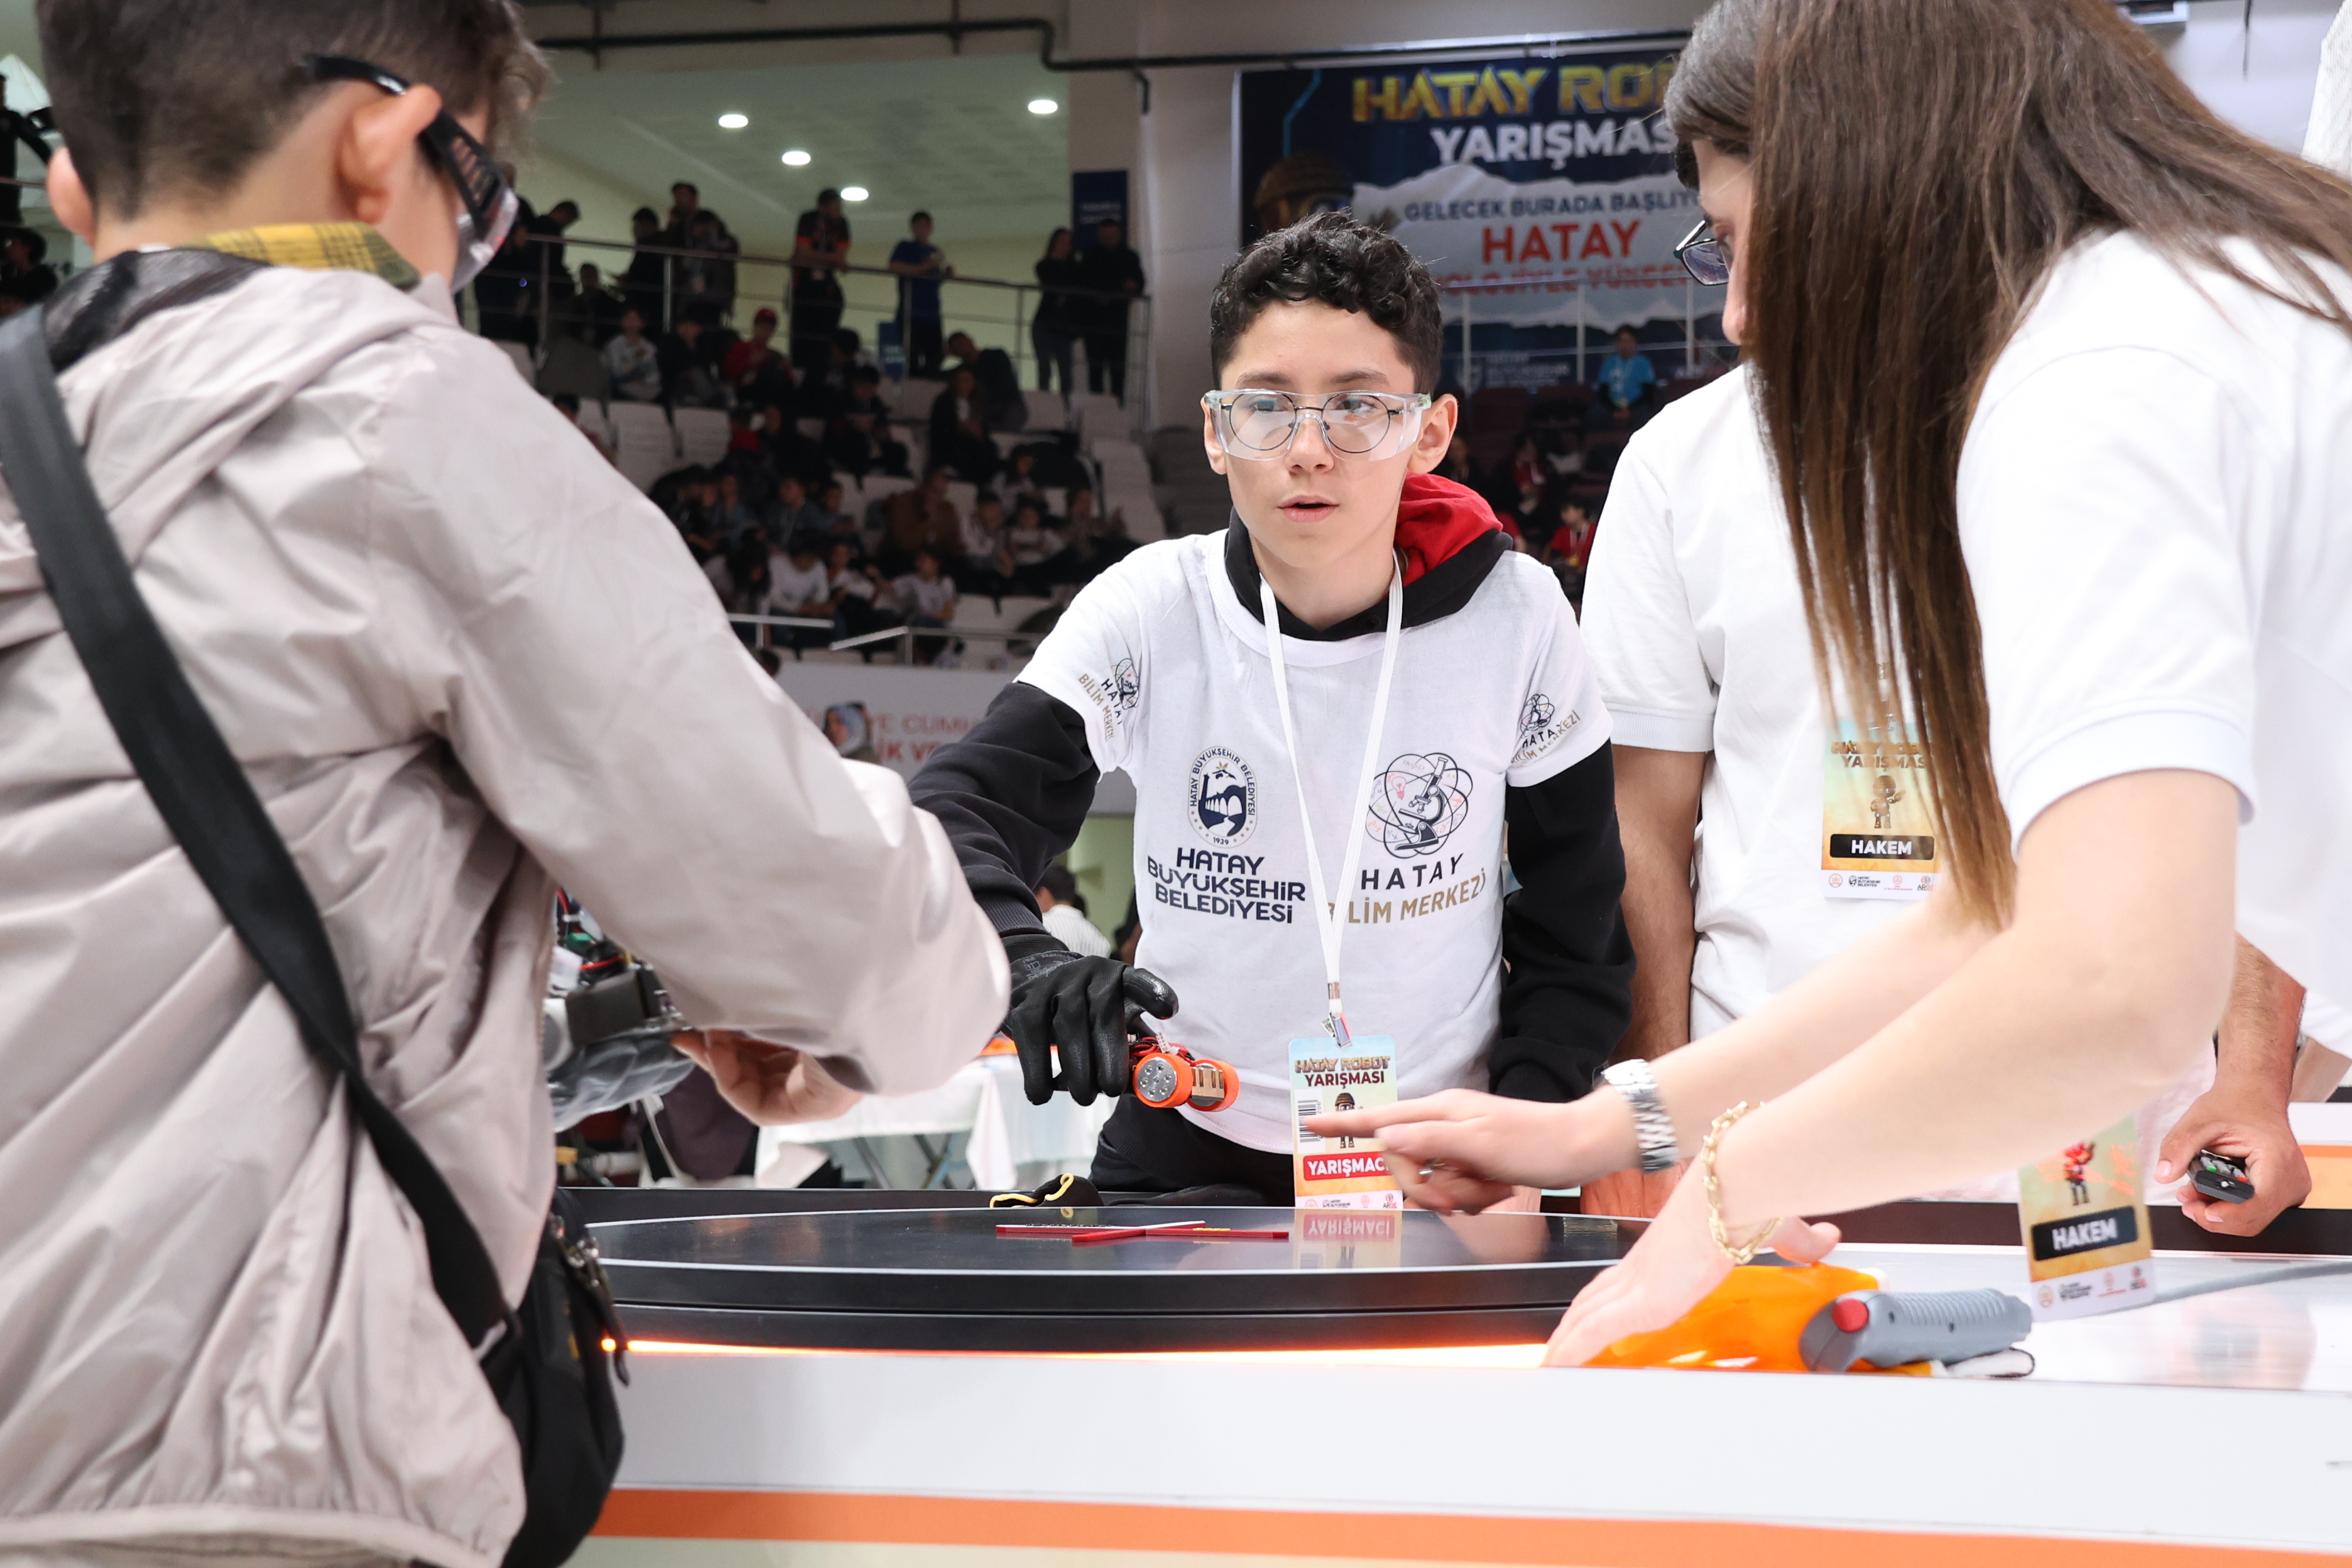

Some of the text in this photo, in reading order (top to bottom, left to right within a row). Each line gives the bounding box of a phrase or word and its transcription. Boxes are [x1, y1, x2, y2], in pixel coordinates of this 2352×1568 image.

[1352, 62, 1676, 122] HATAY RO
[1430, 116, 1678, 170] YARIŞMAS
[1405, 199, 1504, 221] GELECEK
[1511, 195, 1603, 216] BURADA
[1483, 221, 1642, 264] HATAY
[1190, 778, 1198, 807] HATAY
[1213, 837, 1229, 846] 1939
[1851, 840, 1912, 855] HAKEM
[1177, 847, 1265, 875] HATAY
[1361, 853, 1464, 890] HATAY
[1148, 855, 1305, 901] BÜYÜKŞEHİR
[1155, 882, 1292, 923] BELEDİYESİ
[1327, 868, 1486, 923] LİM MERKEZİ
[1295, 1056, 1391, 1073] HATAY ROBOT
[1305, 1070, 1385, 1089] YARIŞMASI
[1307, 1157, 1389, 1177] YARIŞMAC
[2052, 1217, 2118, 1251] HAKEM
